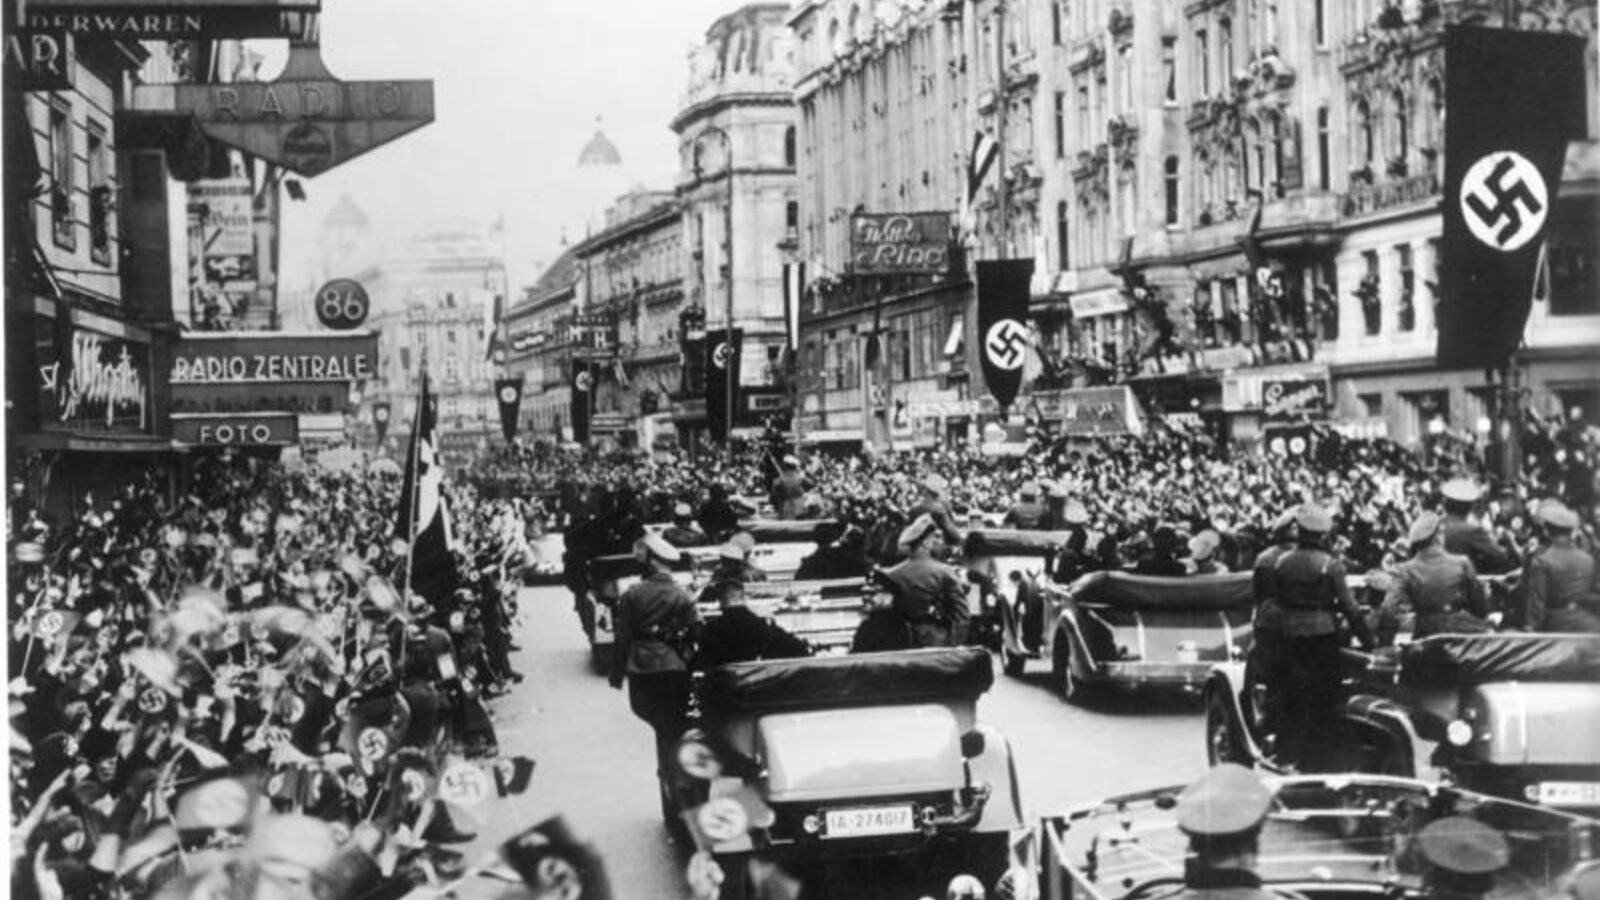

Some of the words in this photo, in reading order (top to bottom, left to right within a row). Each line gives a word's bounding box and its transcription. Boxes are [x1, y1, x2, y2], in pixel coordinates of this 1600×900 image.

[322, 289, 366, 320] 86
[174, 355, 247, 381] RADIO
[253, 353, 368, 381] ZENTRALE
[200, 423, 271, 445] FOTO
